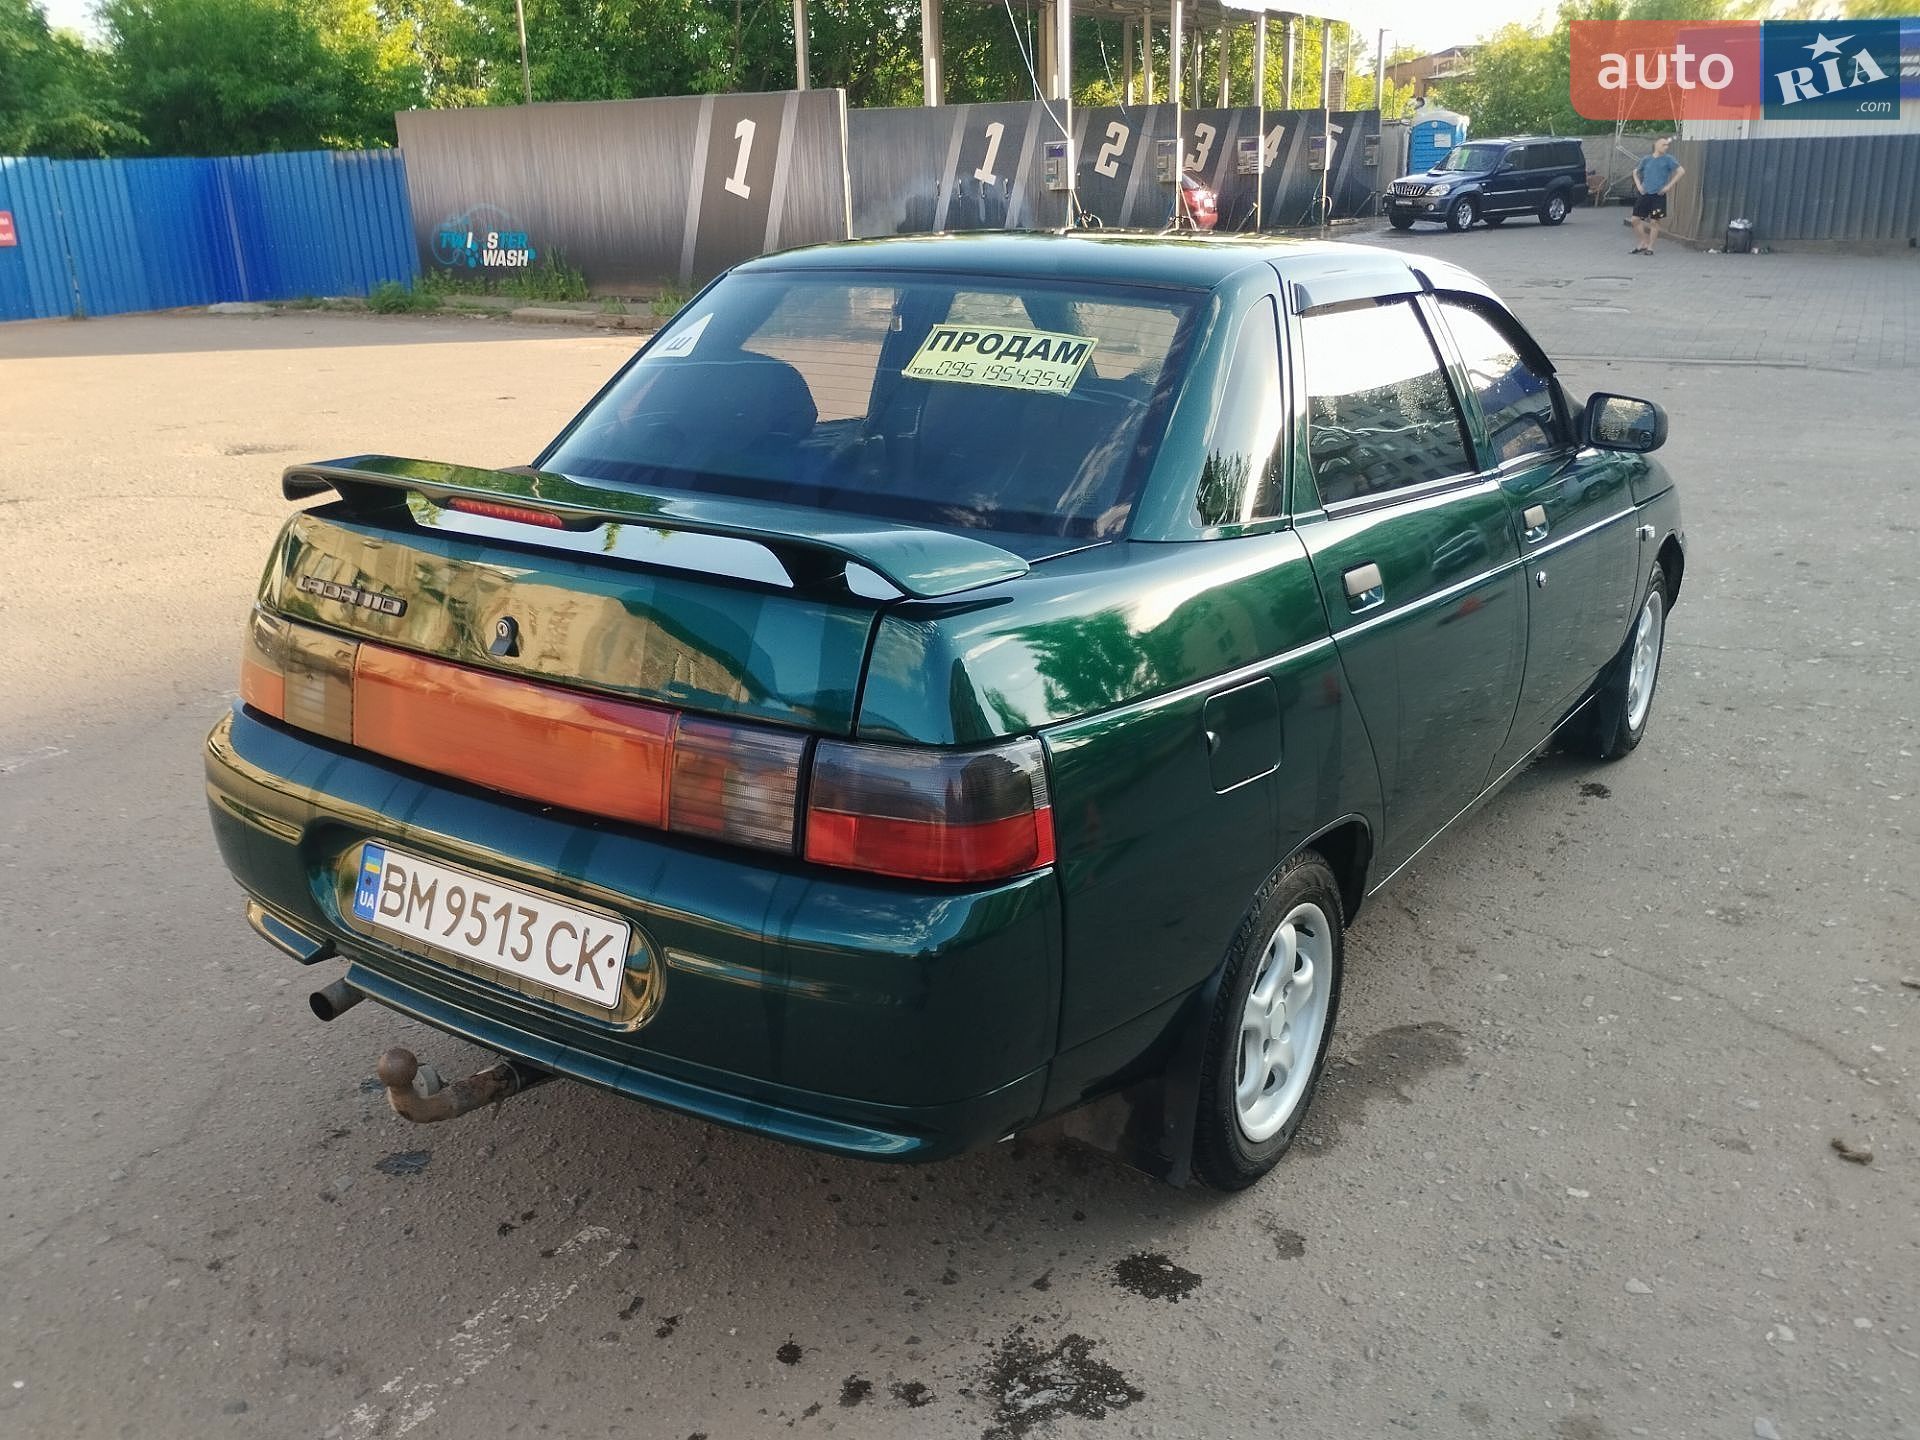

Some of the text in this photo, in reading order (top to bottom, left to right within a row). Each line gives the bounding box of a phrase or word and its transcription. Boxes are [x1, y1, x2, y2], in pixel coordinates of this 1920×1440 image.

[725, 118, 756, 200] 1
[974, 122, 1005, 186] 1
[1094, 121, 1130, 179] 2
[1184, 122, 1217, 173] 3
[1263, 124, 1286, 168] 4
[482, 249, 529, 267] WASH
[926, 330, 1089, 366] ПРОДАМ
[360, 890, 375, 909] UA
[379, 863, 615, 991] BM 9513 CK
